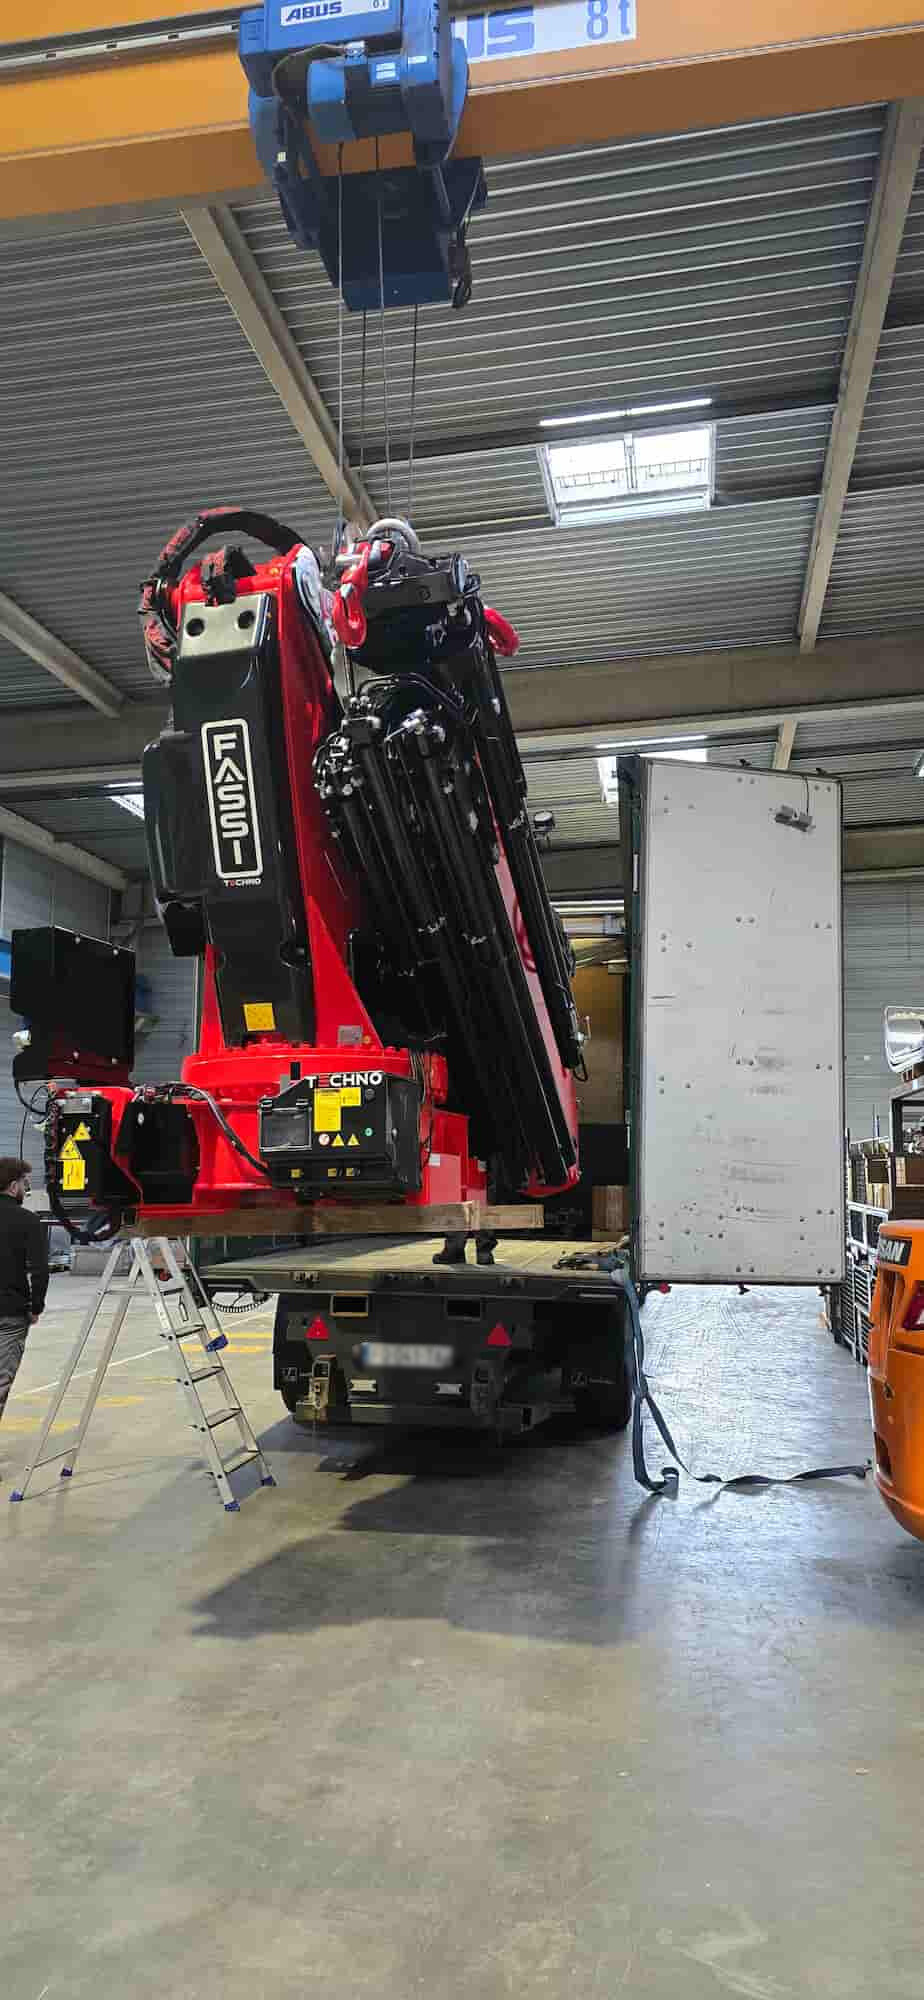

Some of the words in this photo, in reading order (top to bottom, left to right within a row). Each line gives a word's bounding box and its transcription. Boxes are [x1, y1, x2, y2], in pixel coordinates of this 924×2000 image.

[286, 2, 342, 21] ABUS
[213, 732, 249, 865] FASSI
[304, 1071, 383, 1089] TECHNO
